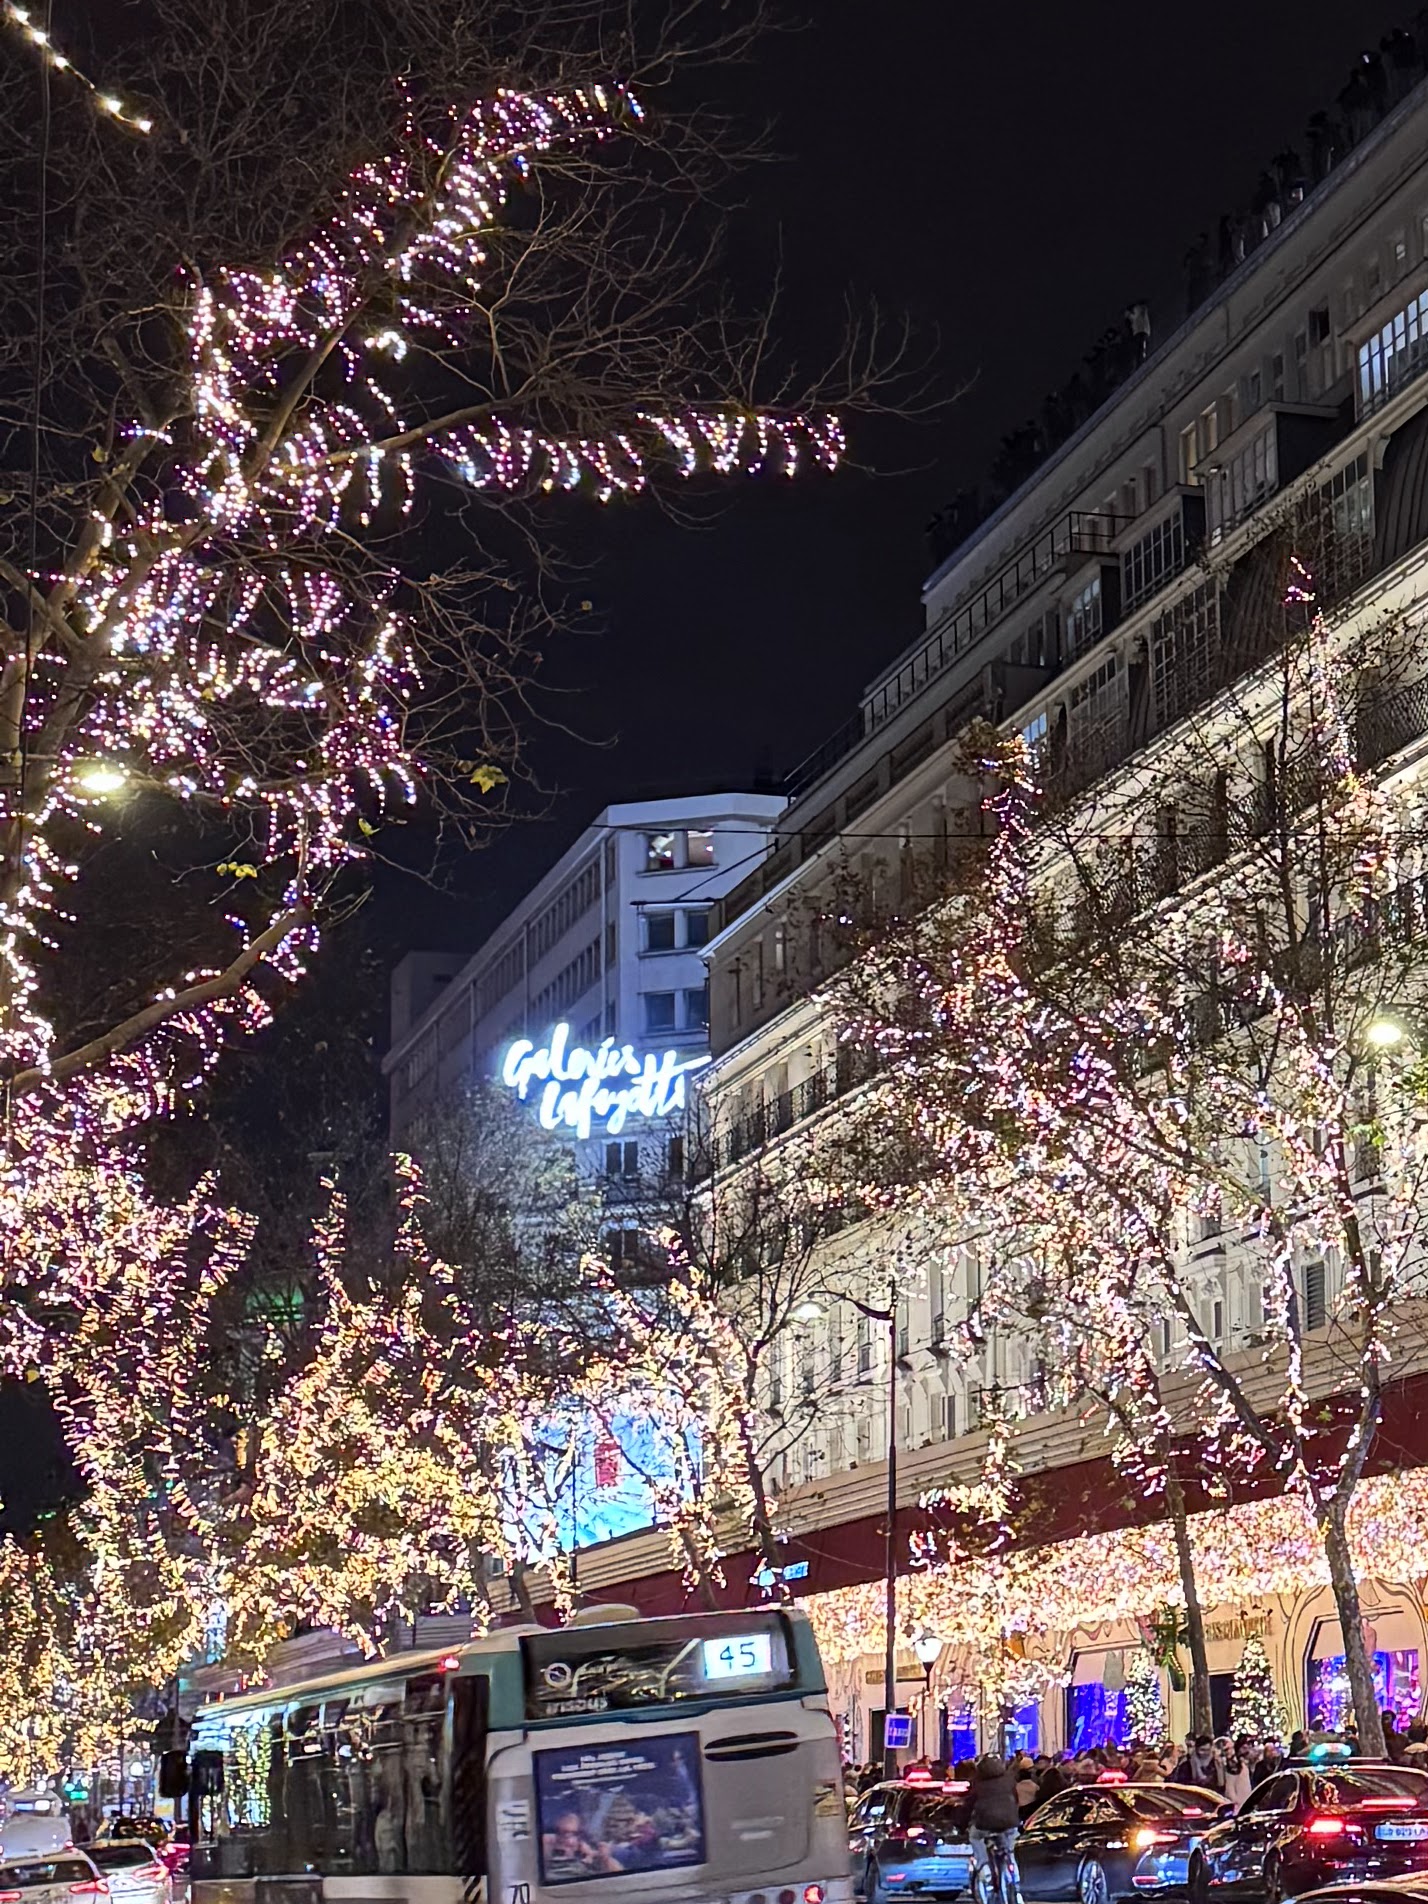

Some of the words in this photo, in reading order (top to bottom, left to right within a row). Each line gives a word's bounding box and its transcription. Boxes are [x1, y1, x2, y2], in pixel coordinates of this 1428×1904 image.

[503, 1022, 641, 1099] Galeries
[539, 1049, 712, 1139] Lafayette
[719, 1642, 756, 1669] 45
